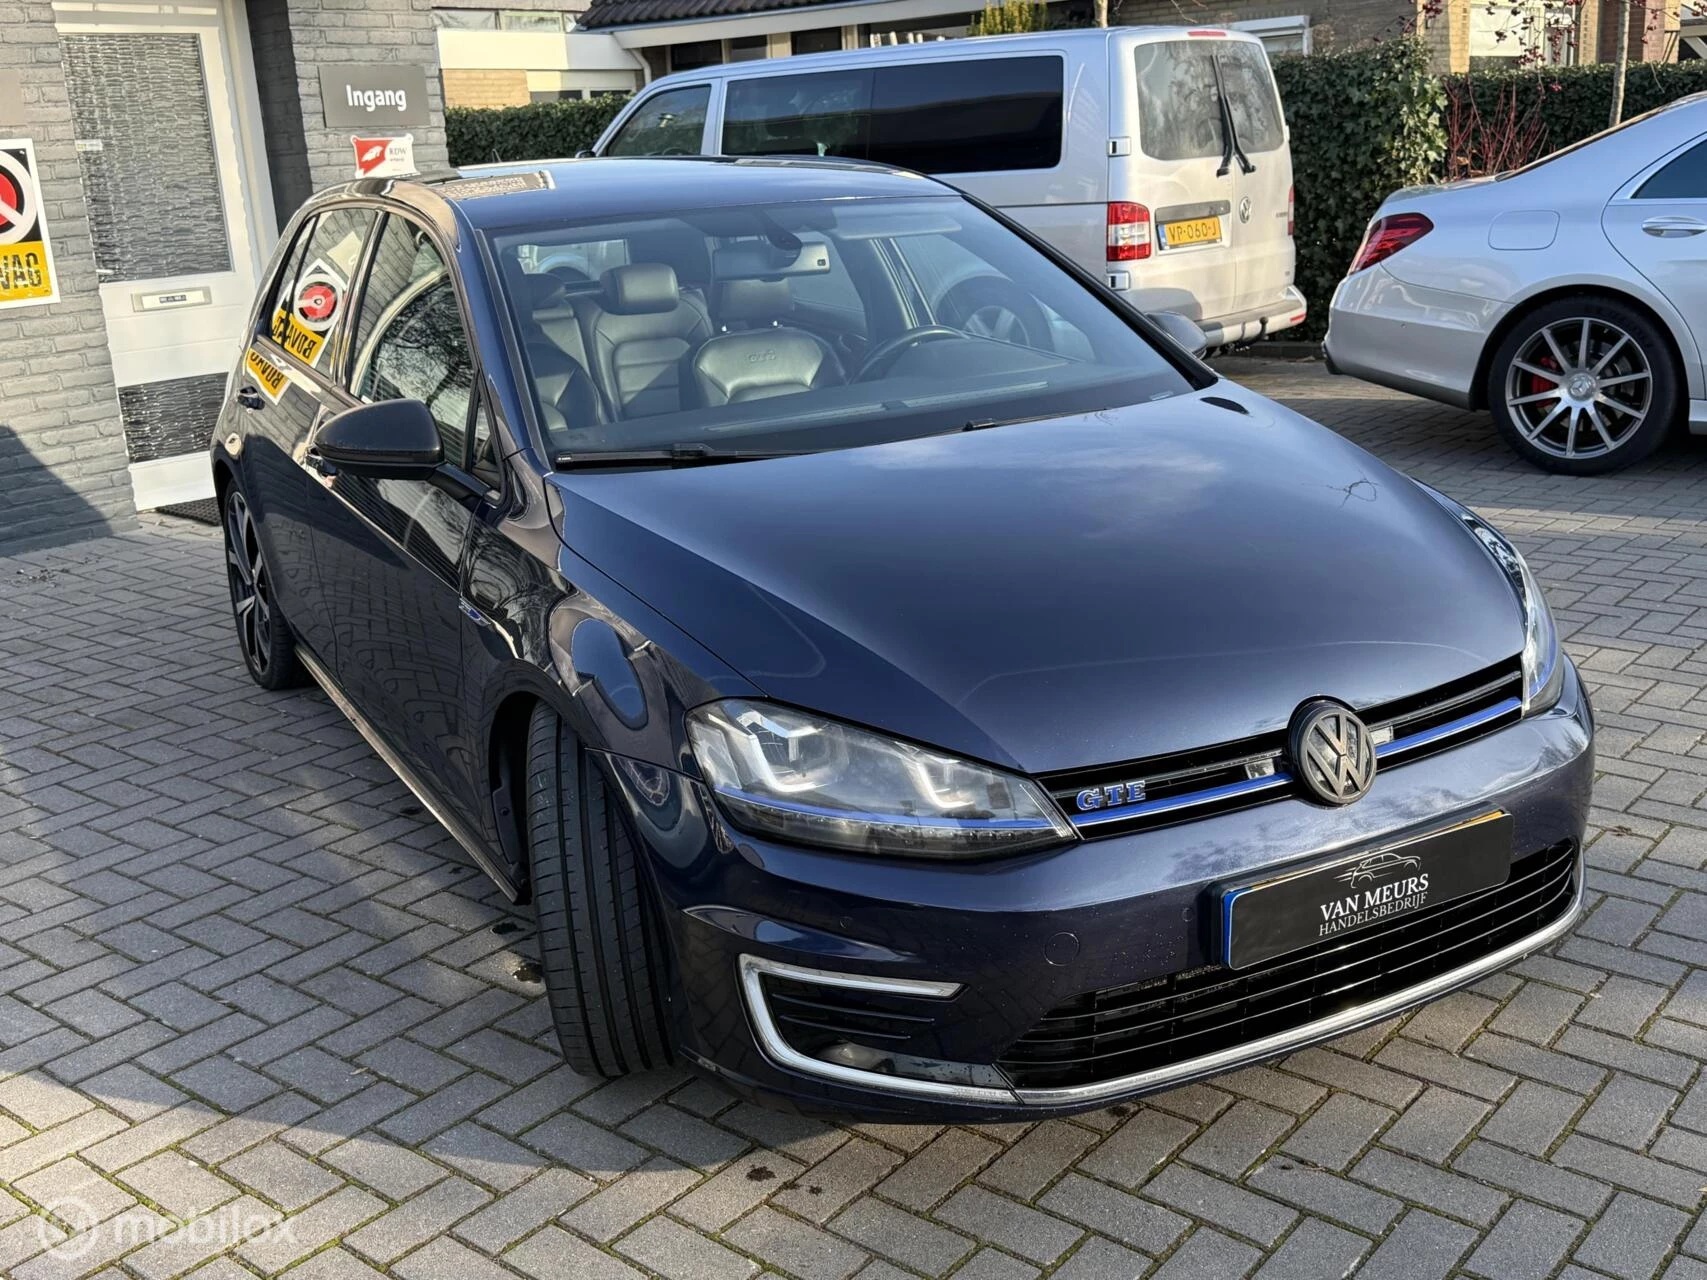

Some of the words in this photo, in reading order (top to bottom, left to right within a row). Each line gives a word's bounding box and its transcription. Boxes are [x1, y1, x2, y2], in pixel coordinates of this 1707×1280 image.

[346, 84, 407, 112] Ingang
[1077, 780, 1146, 811] GTE
[1319, 891, 1428, 937] HANDELSBEDRIJF
[1320, 894, 1360, 921] VAN
[1363, 873, 1429, 909] MEURS
